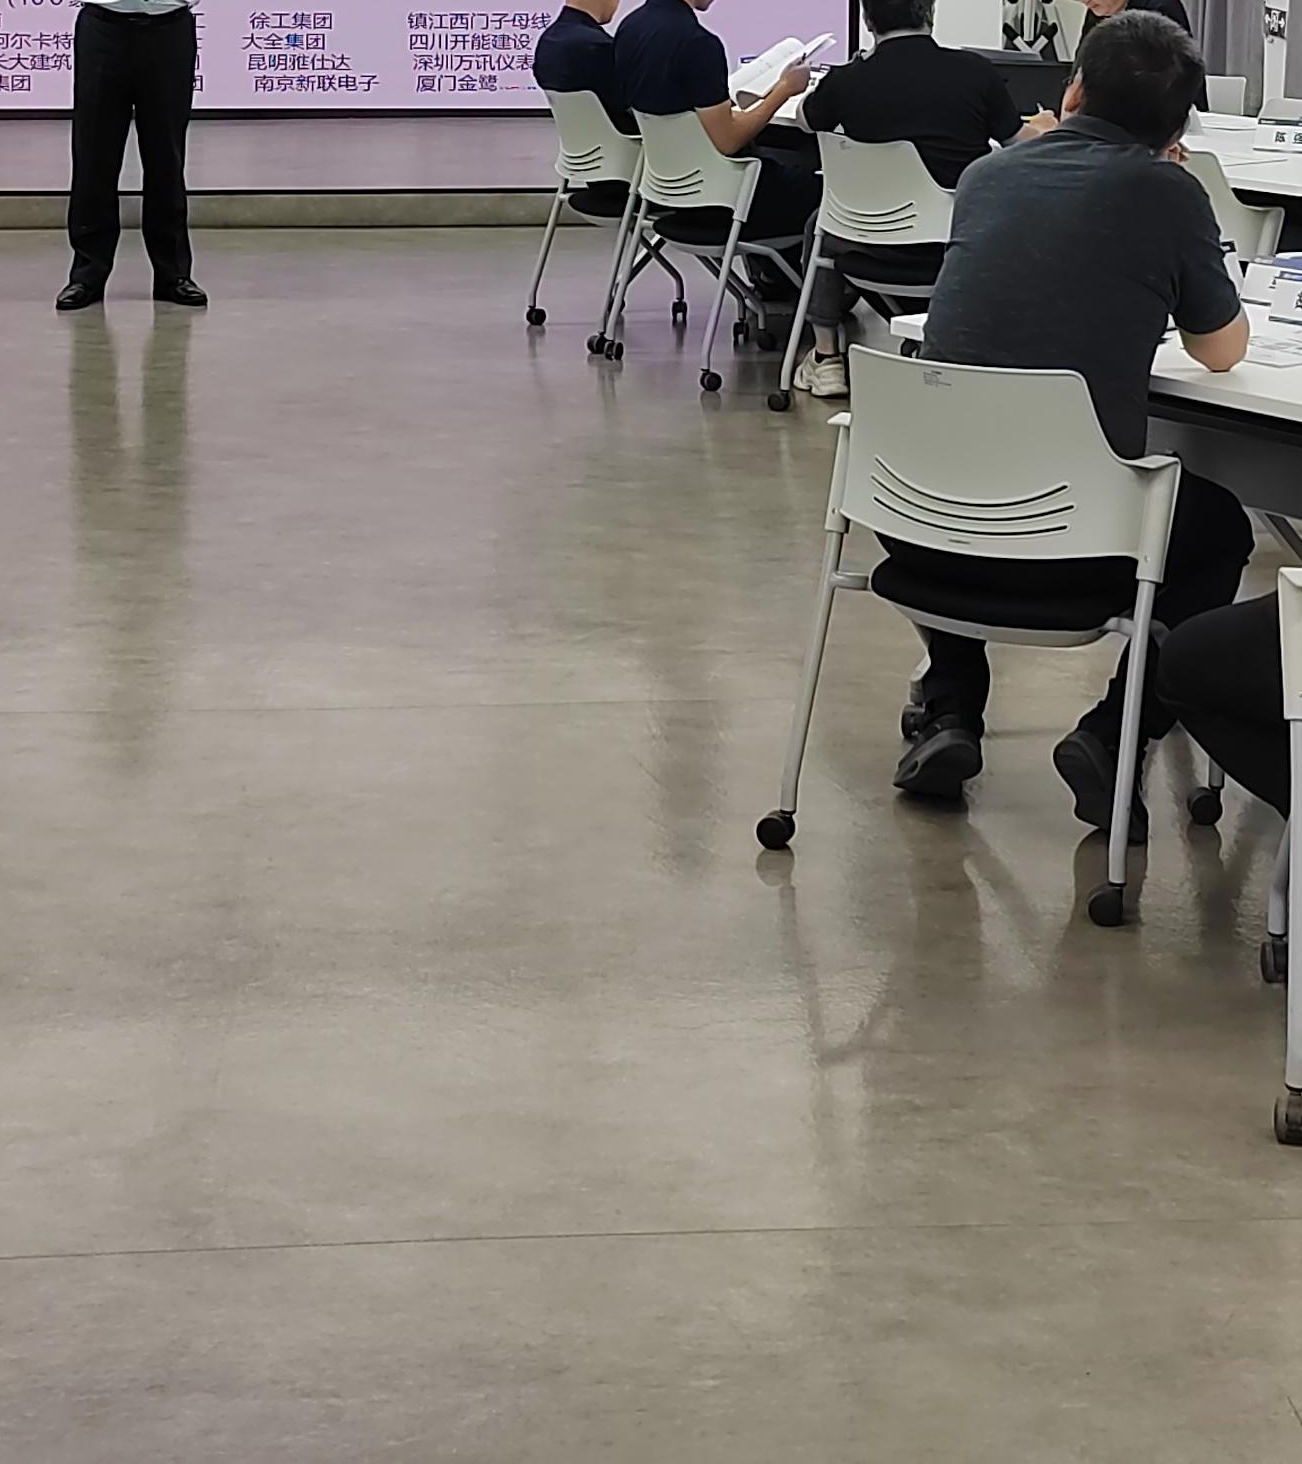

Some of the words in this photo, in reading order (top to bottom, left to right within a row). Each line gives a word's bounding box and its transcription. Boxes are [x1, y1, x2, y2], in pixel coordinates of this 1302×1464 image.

[249, 11, 333, 30] 徐工集团
[407, 12, 551, 30] 镇江西门子母线
[242, 33, 326, 50] 大全集团
[409, 33, 532, 50] 四川开能建设
[413, 53, 533, 71] 深圳万讯仪表
[254, 74, 379, 92] 南京新联电子
